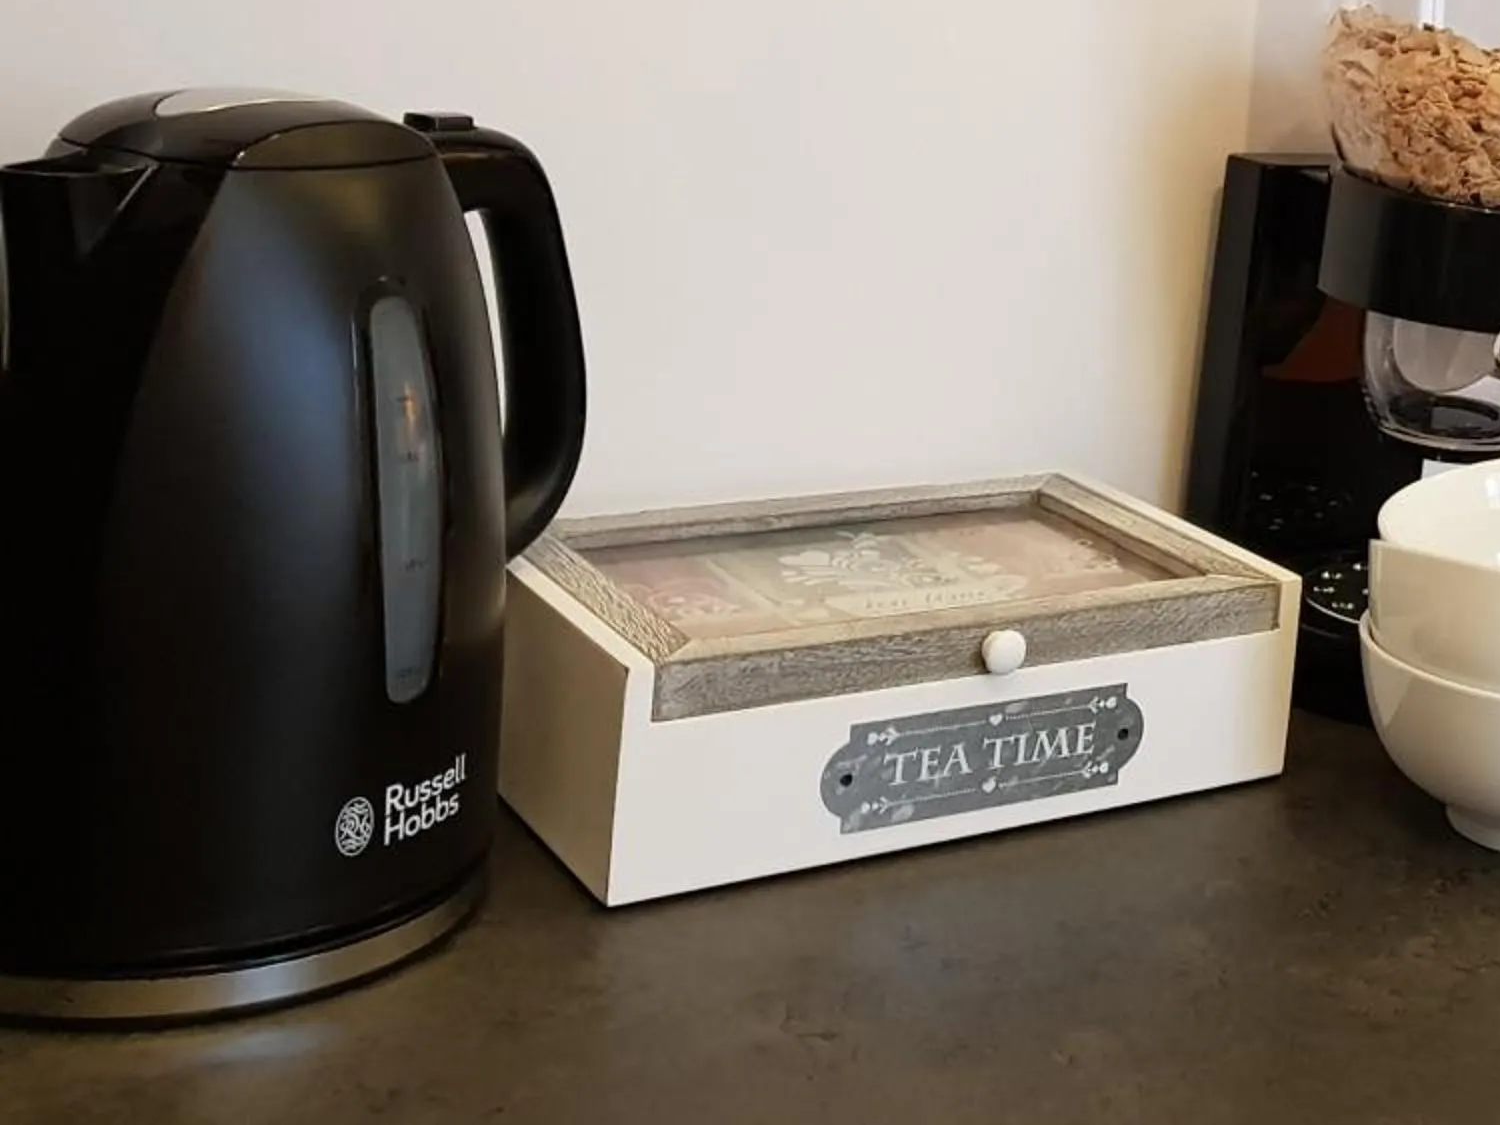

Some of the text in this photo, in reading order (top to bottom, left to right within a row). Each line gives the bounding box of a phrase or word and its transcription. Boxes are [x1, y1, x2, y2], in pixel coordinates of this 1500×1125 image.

[385, 752, 467, 816] Russell
[884, 721, 1098, 787] TEA TIME
[383, 792, 460, 847] Hobbs
